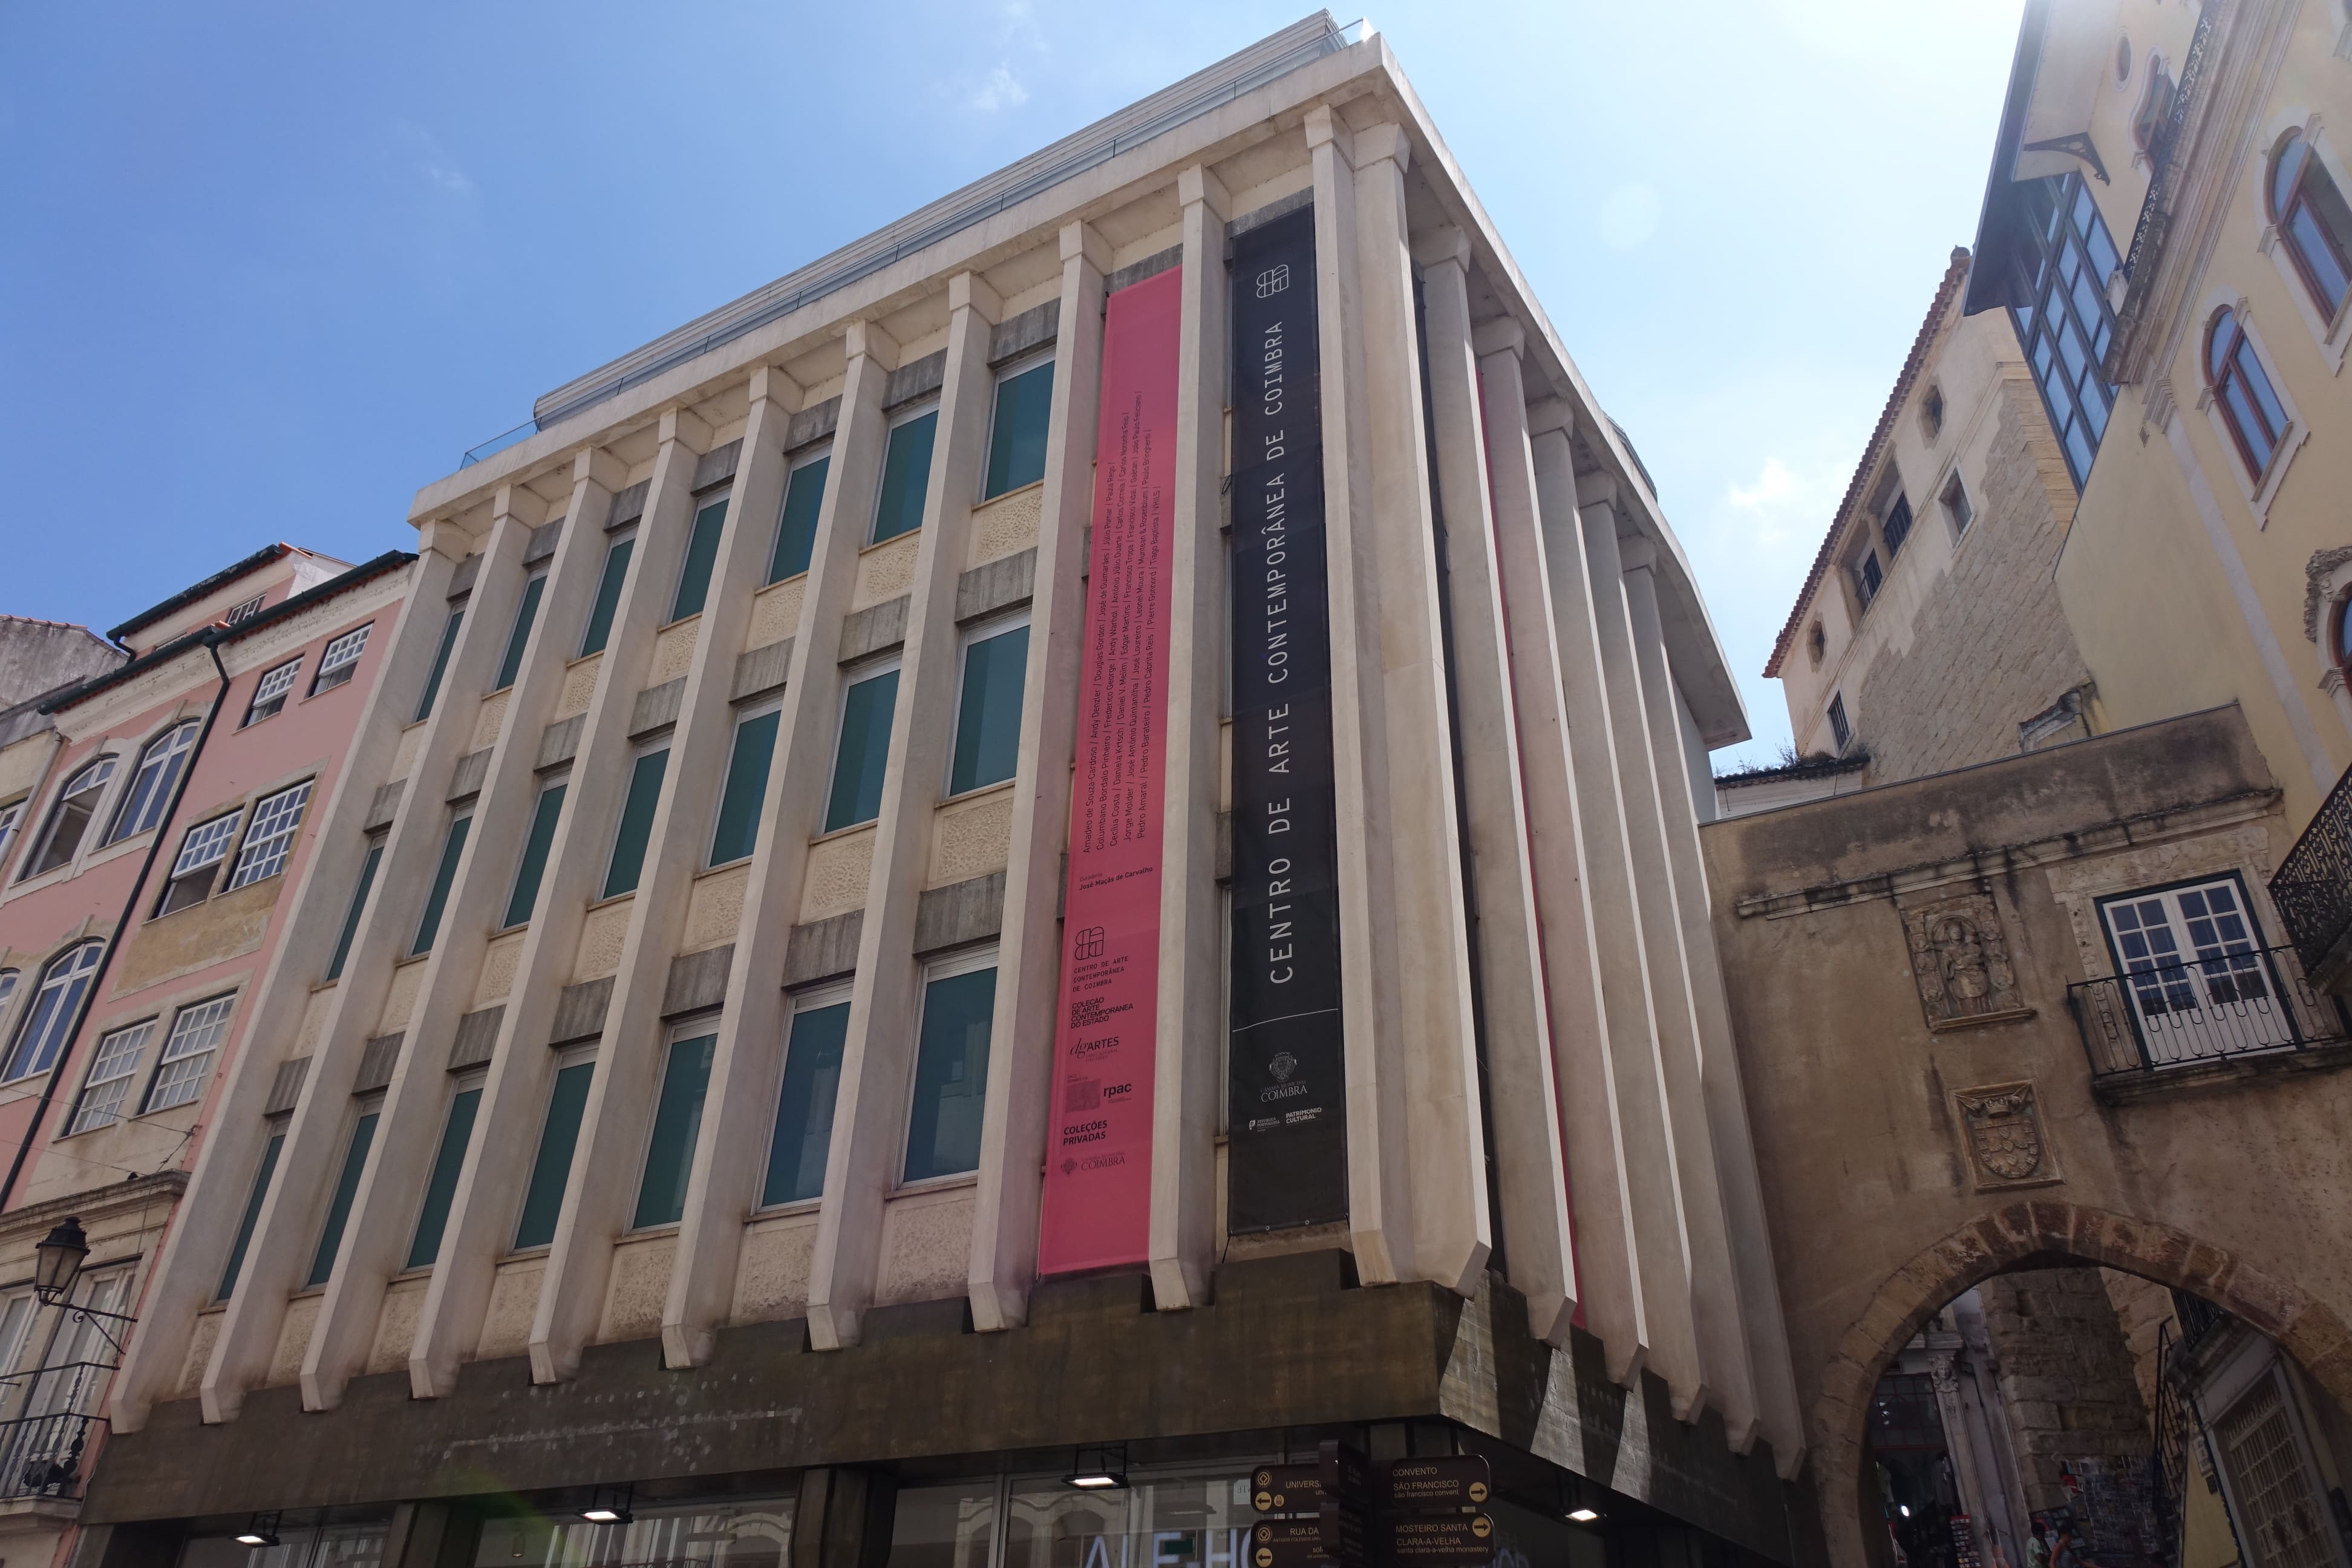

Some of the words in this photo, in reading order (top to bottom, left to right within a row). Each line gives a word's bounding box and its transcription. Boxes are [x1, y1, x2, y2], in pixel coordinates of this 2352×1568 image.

[1264, 321, 1282, 416] COIMBRA
[1266, 430, 1284, 461] DE
[1150, 546, 1158, 566] Tiago
[1261, 472, 1288, 683] CONTEMPORÂNEA
[1109, 610, 1118, 636] Warhol
[1096, 624, 1105, 650] Gordon
[1109, 638, 1117, 655] Andy
[1132, 626, 1142, 656] Loureiro
[1094, 652, 1104, 681] Douglas
[1106, 664, 1116, 690] George
[1145, 652, 1153, 679] Cabrita
[1143, 680, 1152, 703] Pedro
[1104, 692, 1113, 728] Frederico
[1113, 755, 1122, 785] Daniela
[1120, 635, 1129, 655] Edgar
[1129, 683, 1138, 726] Quintanilha
[1091, 720, 1100, 738] Andy
[1142, 711, 1150, 747] Barateiro
[1269, 703, 1289, 773] ARTE
[1102, 736, 1110, 768] Pinheiro
[1140, 750, 1148, 773] Pedro
[1086, 746, 1097, 806] Souza-Cardoso
[1126, 759, 1135, 777] José
[1099, 770, 1108, 802] Bordalo
[1086, 808, 1093, 818] de
[1268, 798, 1290, 834] DE
[1083, 820, 1093, 853] Amadeo
[1096, 803, 1106, 850] Columbano
[1124, 818, 1133, 841] Jorge
[1137, 813, 1146, 838] Pedro
[1079, 881, 1093, 890] José
[1125, 867, 1152, 878] Carvalho
[1269, 858, 1293, 983] CENTRO
[1074, 964, 1097, 973] CENTRO
[1113, 956, 1128, 964] ARTE
[1085, 978, 1112, 990] COIMBRA
[1082, 1004, 1100, 1013] ARTE
[1083, 1015, 1109, 1026] ESTADO
[1103, 1083, 1131, 1098] rpac
[1261, 1085, 1307, 1102] COIMBRA
[1063, 1120, 1108, 1135] COLEÇÕES
[1286, 1114, 1316, 1123] CULTURAL
[1063, 1131, 1106, 1146] PRIVADAS
[1081, 1156, 1125, 1171] COIMBRA
[1393, 1467, 1437, 1476] CONVENTO
[1393, 1481, 1410, 1491] SÃO
[1412, 1480, 1459, 1489] FRANCISCO
[1290, 1527, 1307, 1536] RUA
[1396, 1524, 1439, 1534] MOSTEIRO
[1397, 1537, 1462, 1546] CLARA-A-VELHA
